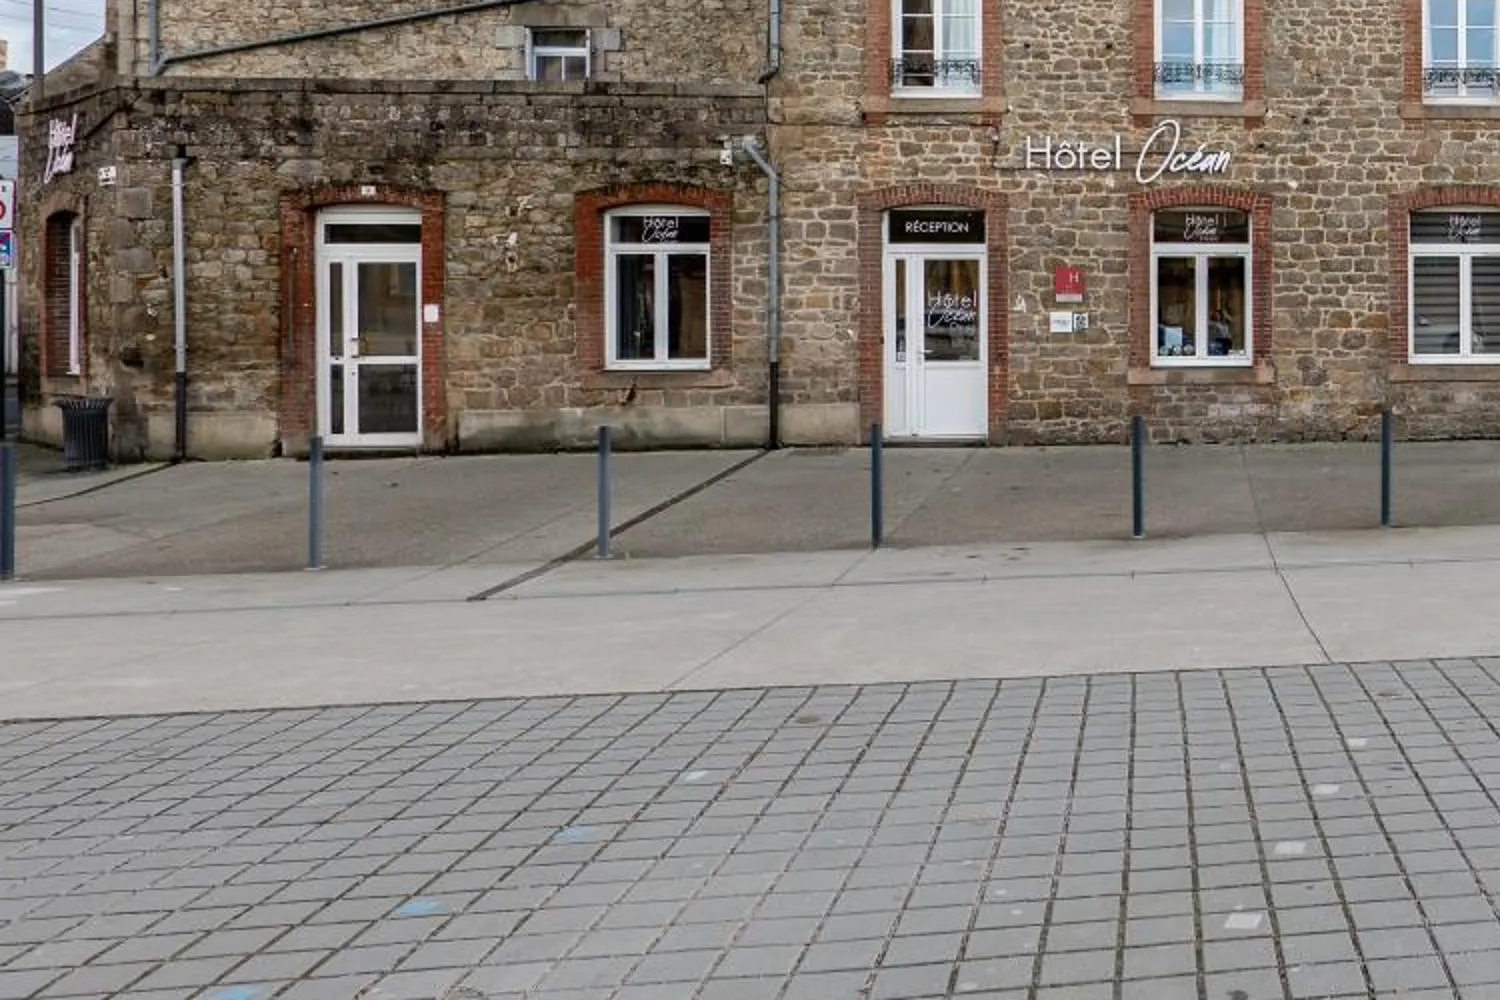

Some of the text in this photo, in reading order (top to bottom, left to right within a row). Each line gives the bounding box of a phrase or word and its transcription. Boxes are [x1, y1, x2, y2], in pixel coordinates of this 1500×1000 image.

[1026, 119, 1231, 183] Hôtel Océan
[905, 219, 969, 233] RÉCEPTION
[1069, 271, 1079, 284] H
